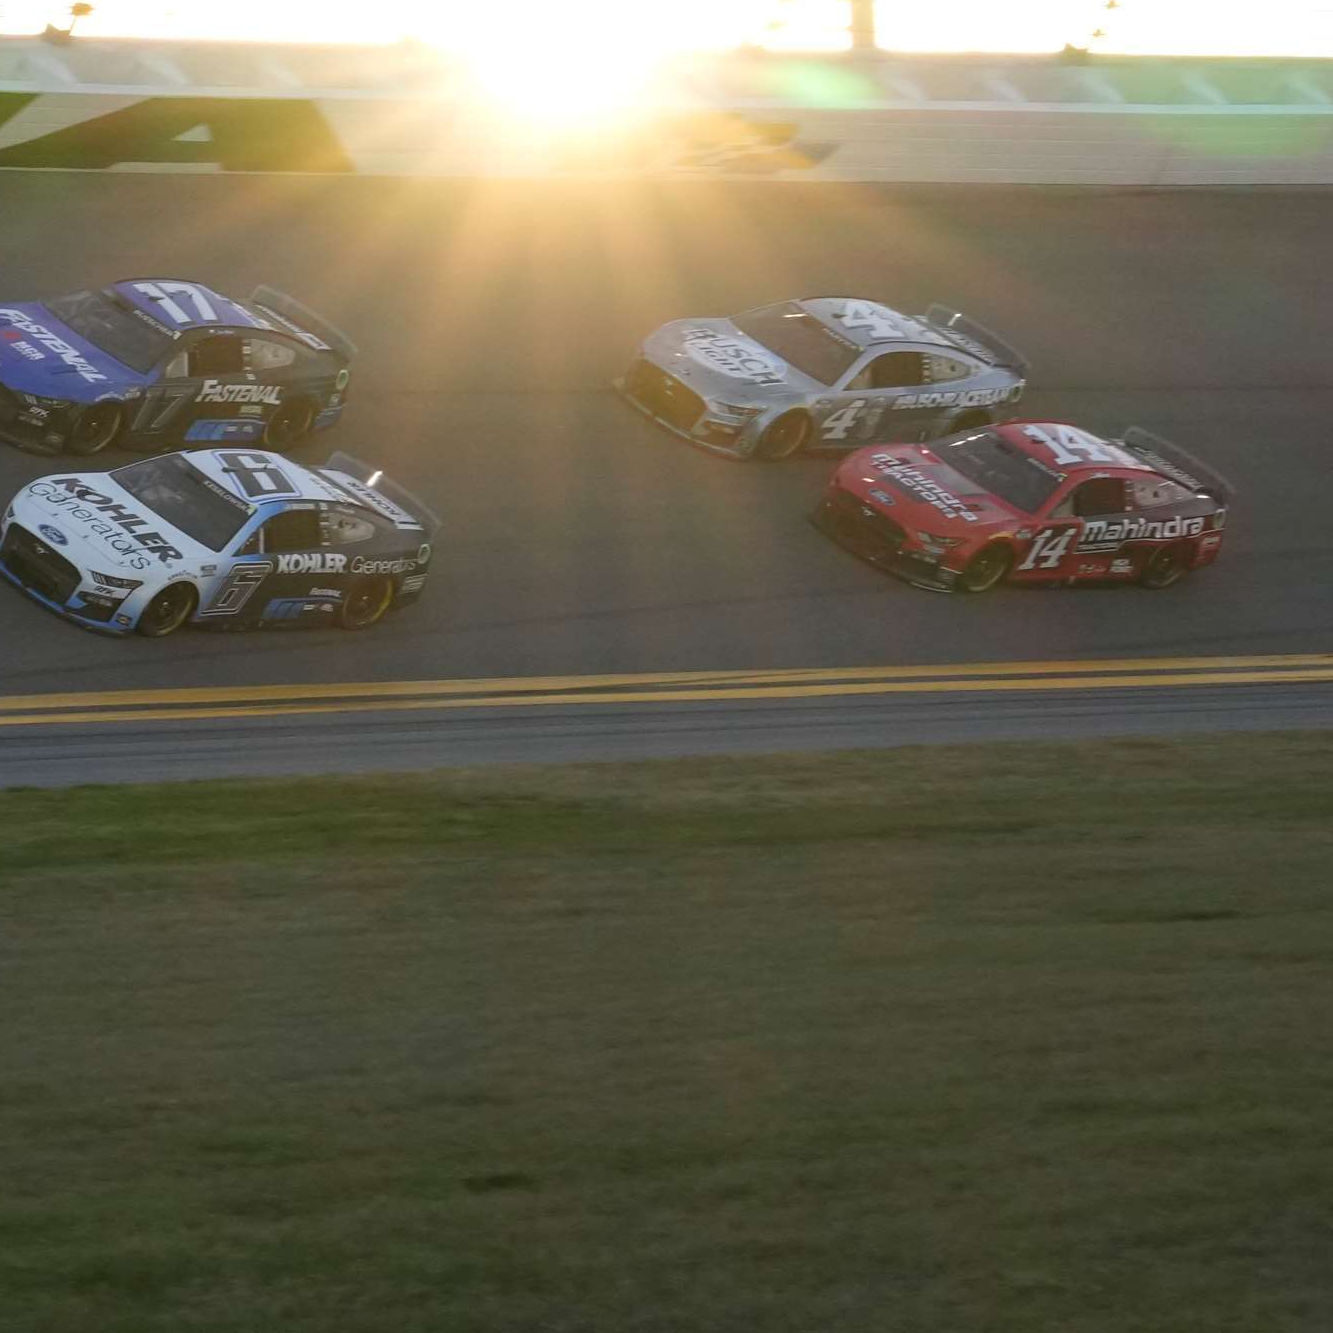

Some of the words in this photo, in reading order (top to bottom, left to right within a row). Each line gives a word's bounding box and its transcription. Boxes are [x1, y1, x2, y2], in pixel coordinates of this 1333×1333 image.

[133, 283, 217, 323] 17
[842, 301, 906, 340] 4
[821, 399, 865, 440] 4
[1022, 425, 1113, 465] 14
[216, 452, 298, 500] 6
[28, 482, 151, 570] Generators
[52, 478, 183, 564] KOHLER
[277, 553, 347, 575] KOHLER
[350, 556, 417, 574] Generators
[1017, 528, 1078, 570] 14
[199, 561, 273, 616] 6
